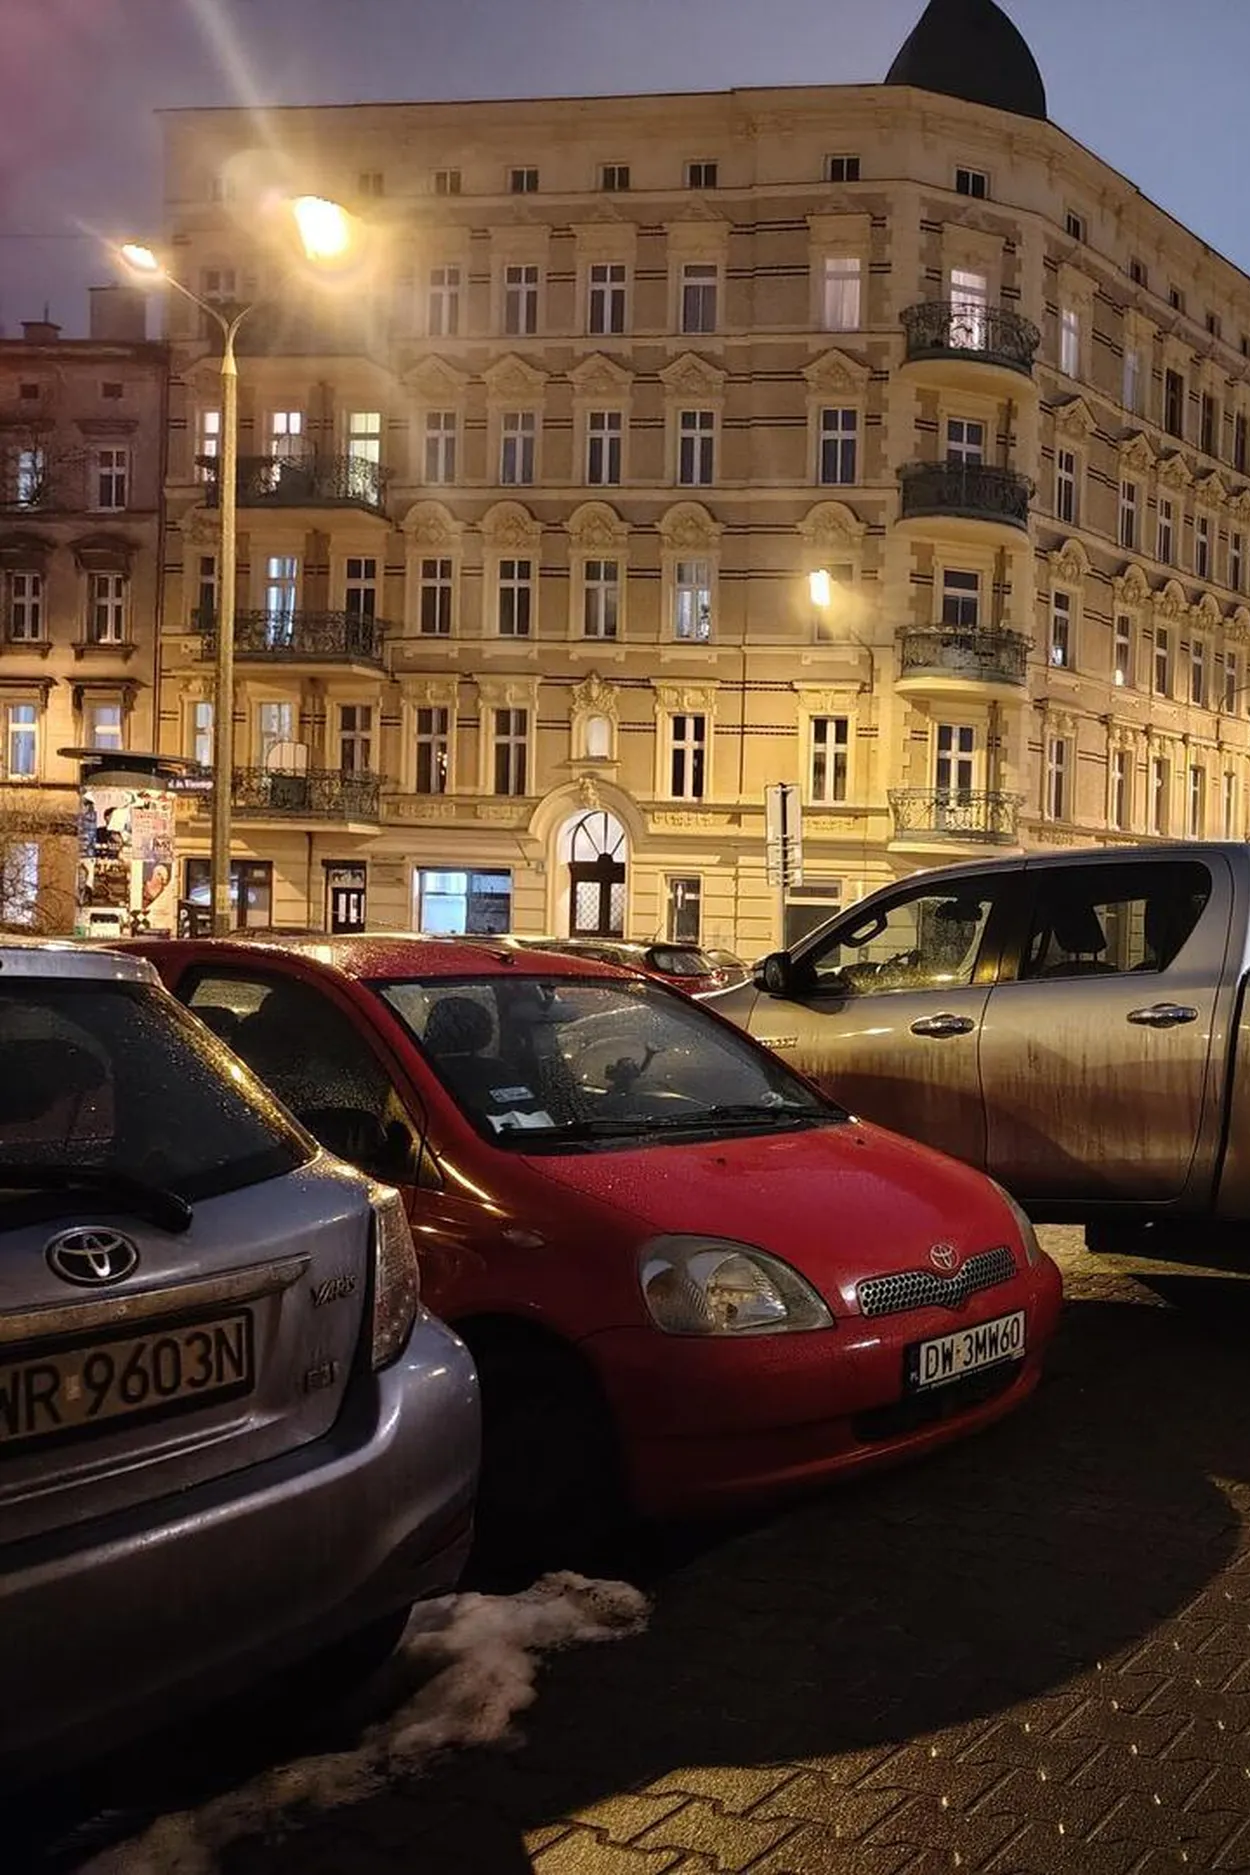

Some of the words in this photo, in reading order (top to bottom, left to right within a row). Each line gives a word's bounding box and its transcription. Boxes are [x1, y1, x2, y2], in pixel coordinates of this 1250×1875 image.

[83, 1323, 244, 1416] 9603N
[926, 1339, 954, 1379] DW
[963, 1317, 1020, 1366] 3MW60
